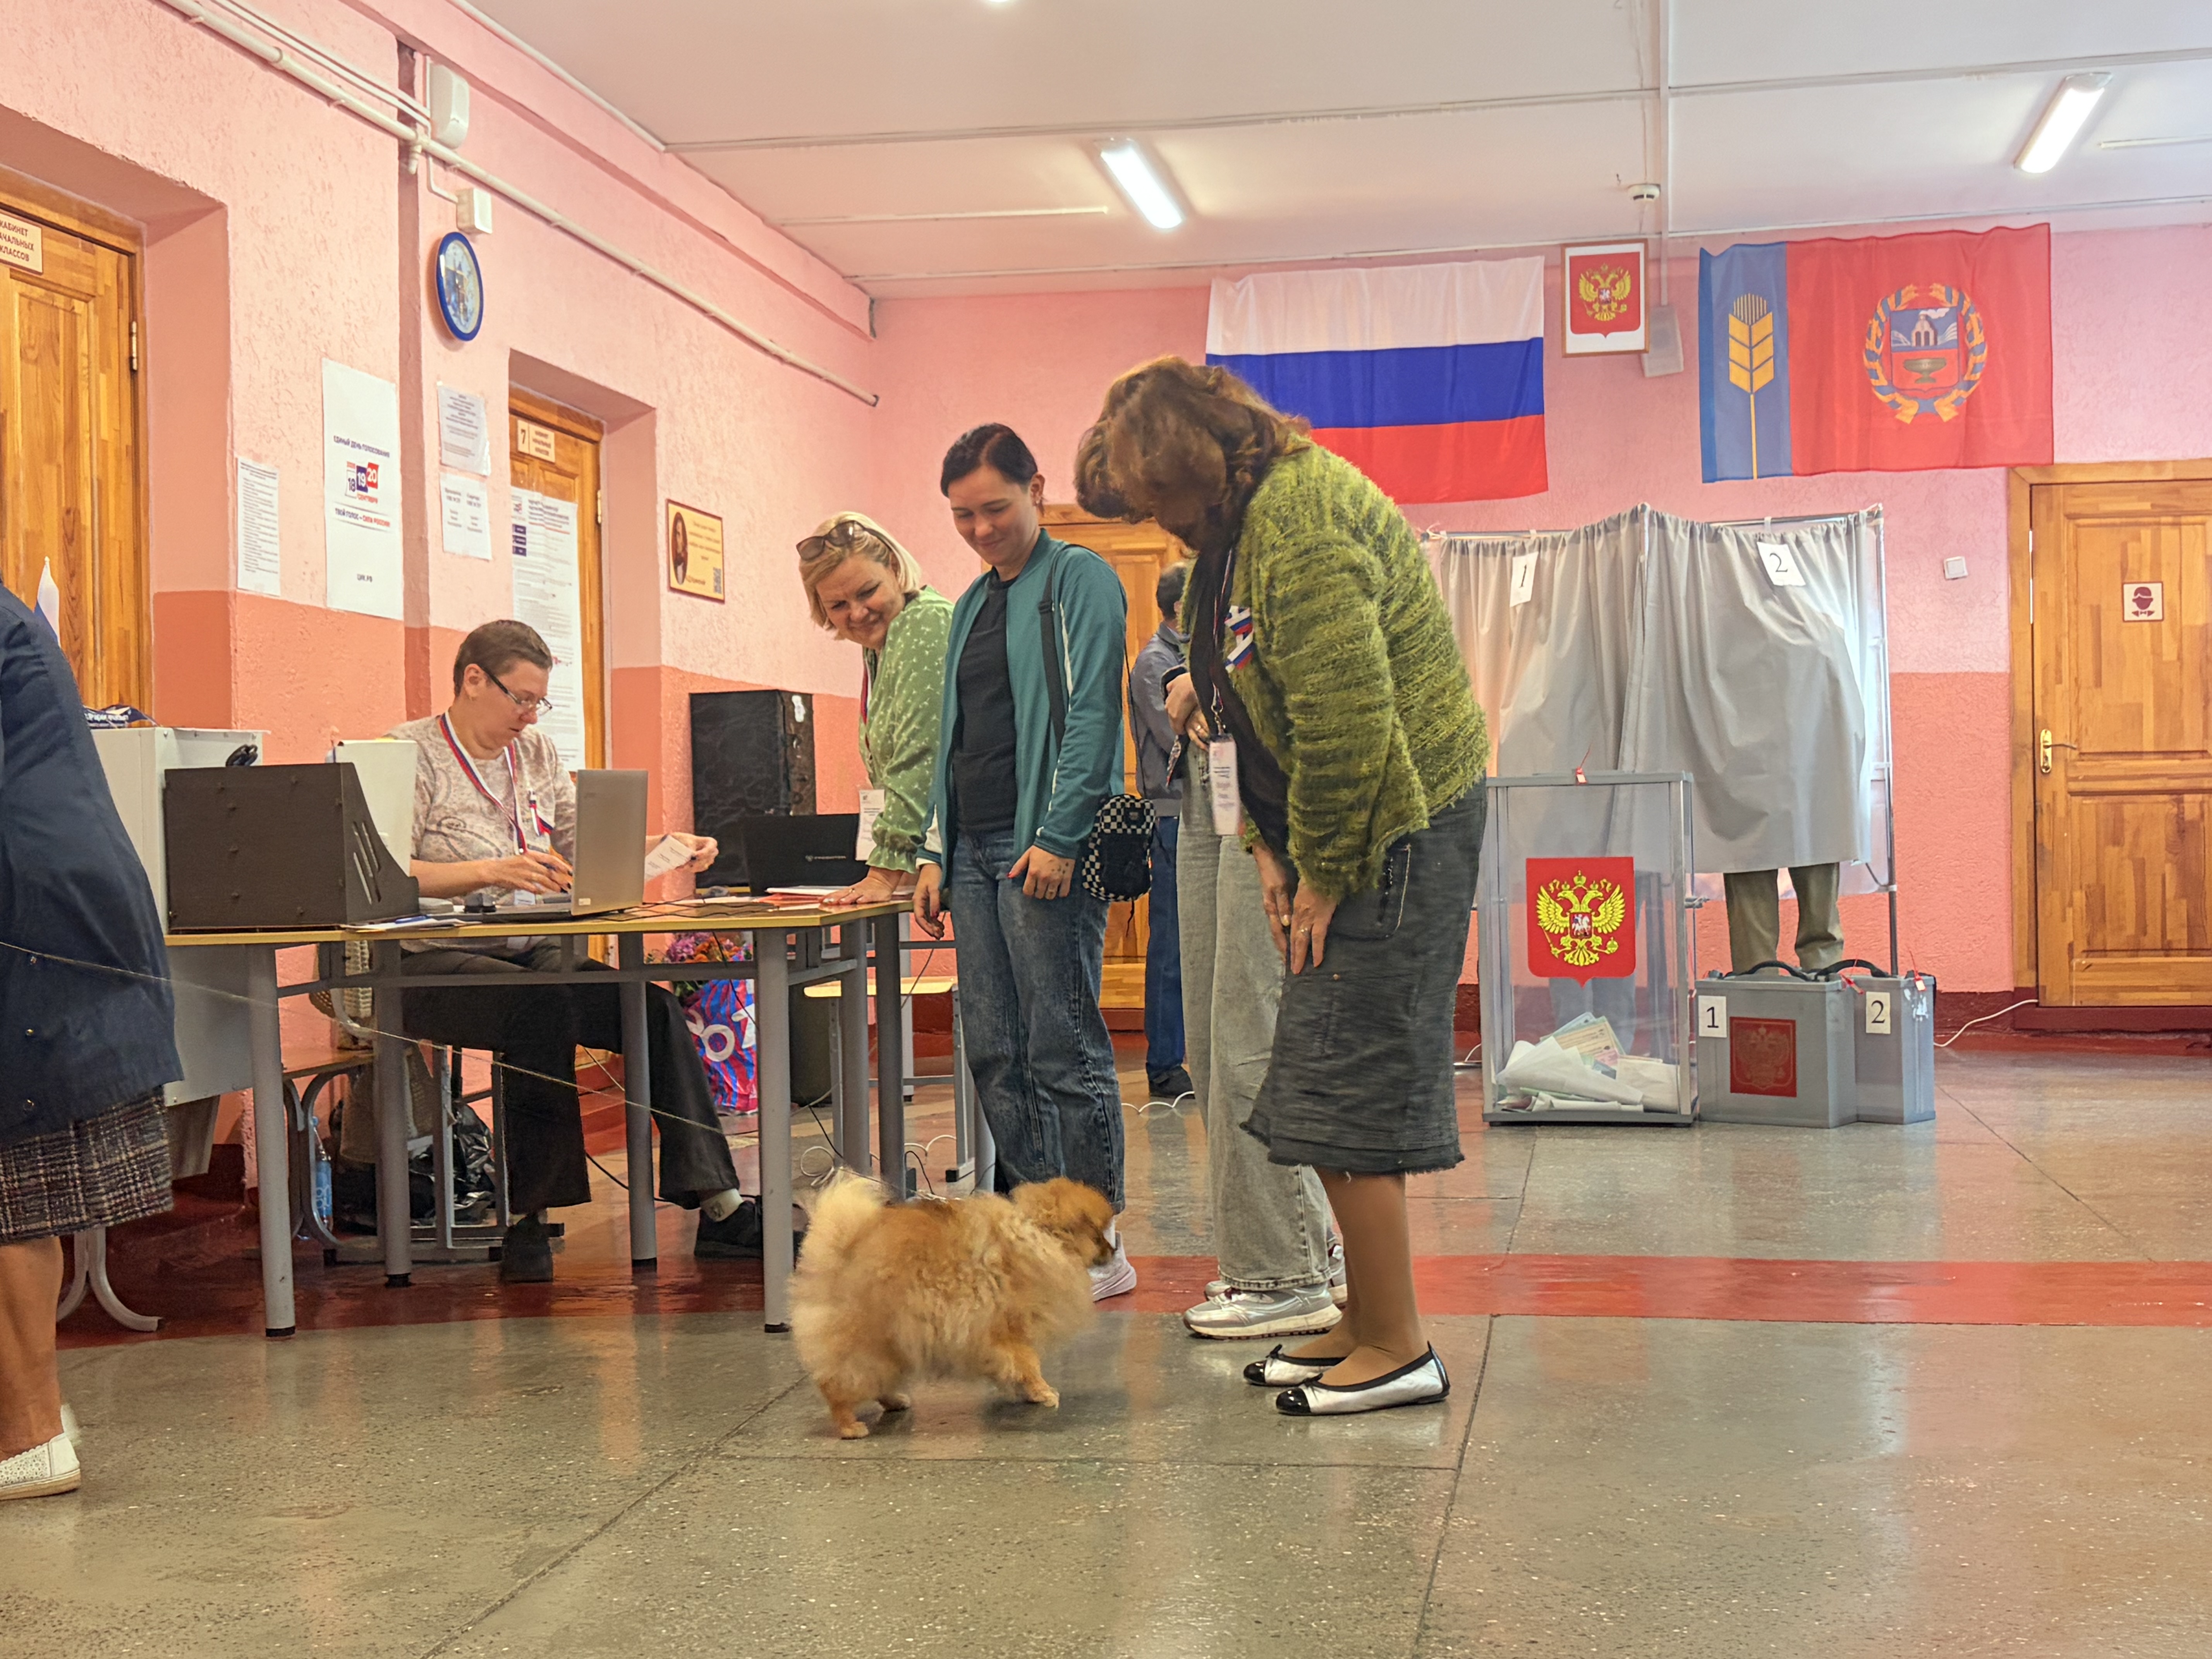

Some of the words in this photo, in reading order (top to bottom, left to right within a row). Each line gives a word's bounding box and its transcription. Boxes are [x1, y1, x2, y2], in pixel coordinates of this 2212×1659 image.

[520, 429, 526, 444] 7
[348, 478, 356, 492] 18
[357, 472, 366, 487] 19
[367, 468, 377, 483] 20
[1769, 553, 1788, 572] 2
[1519, 564, 1527, 588] 1
[1707, 1006, 1719, 1028] 1
[1871, 1000, 1885, 1023] 2
